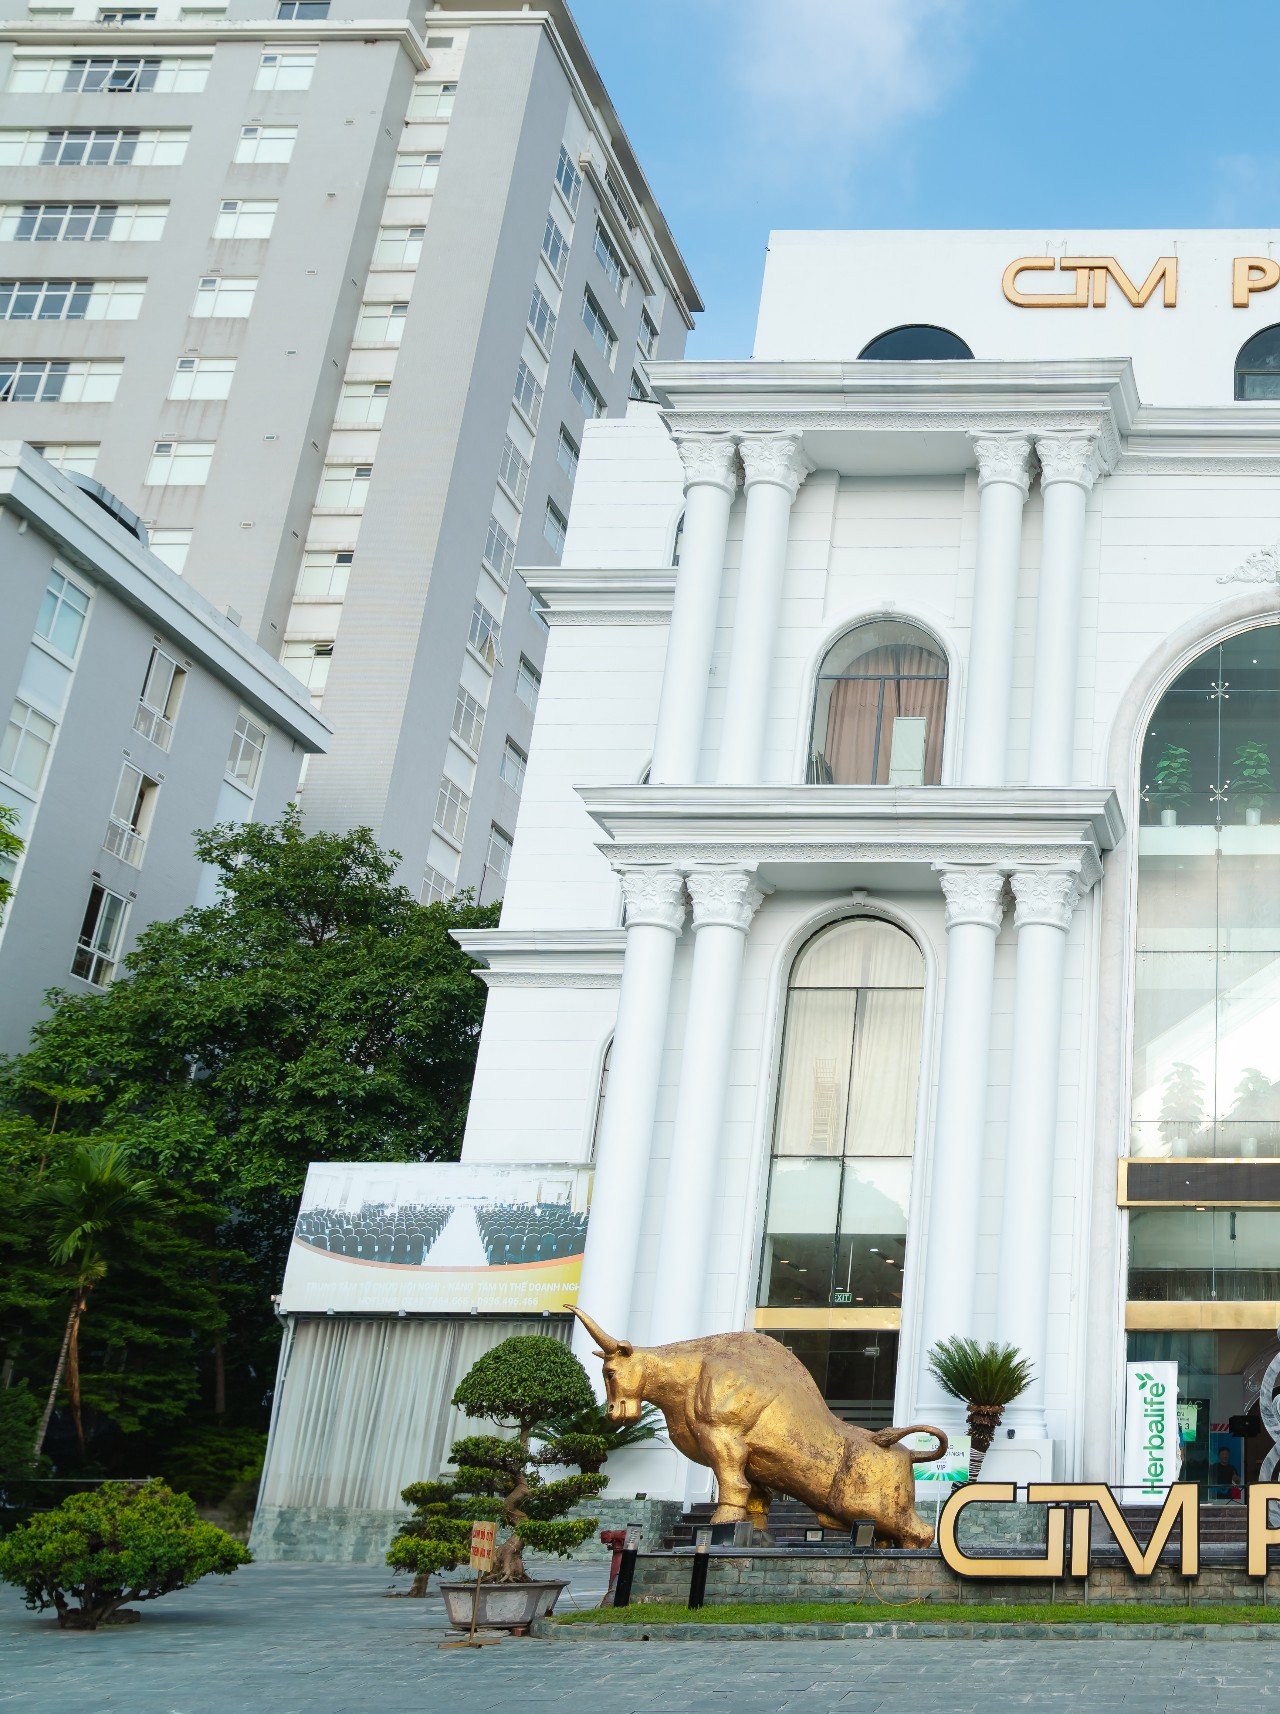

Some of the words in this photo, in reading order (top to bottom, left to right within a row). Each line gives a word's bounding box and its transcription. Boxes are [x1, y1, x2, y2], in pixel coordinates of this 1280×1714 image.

[1001, 256, 1178, 308] CTM
[529, 1283, 560, 1292] DOANH
[562, 1283, 580, 1291] NGH
[1142, 1382, 1166, 1495] Herbalife
[938, 1481, 1200, 1579] CTM
